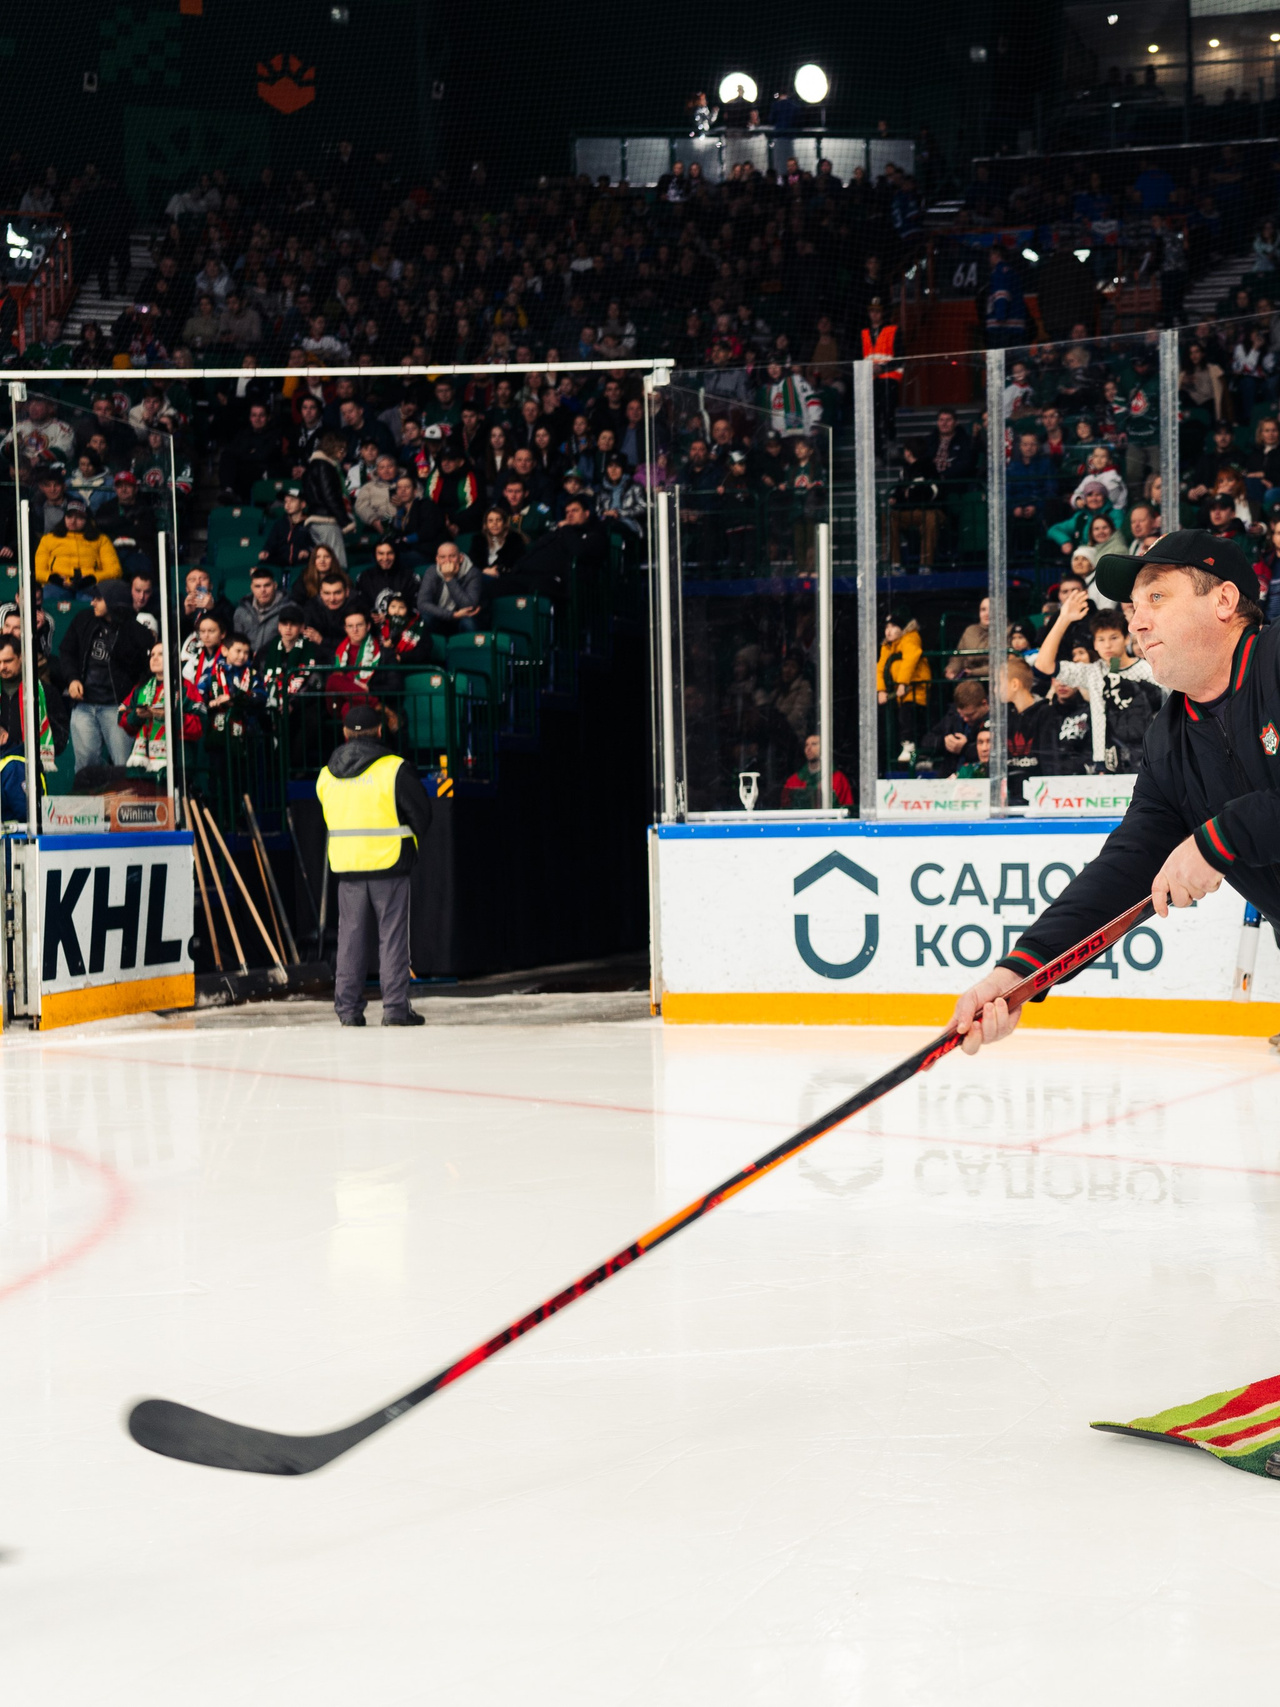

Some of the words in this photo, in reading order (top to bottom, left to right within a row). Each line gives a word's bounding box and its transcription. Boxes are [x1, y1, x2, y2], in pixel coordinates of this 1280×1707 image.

[902, 799, 982, 811] TATNEFT
[1052, 797, 1132, 809] TATNEFT
[57, 813, 99, 826] TATNEFT
[120, 806, 154, 821] Winline
[42, 863, 183, 981] KHL
